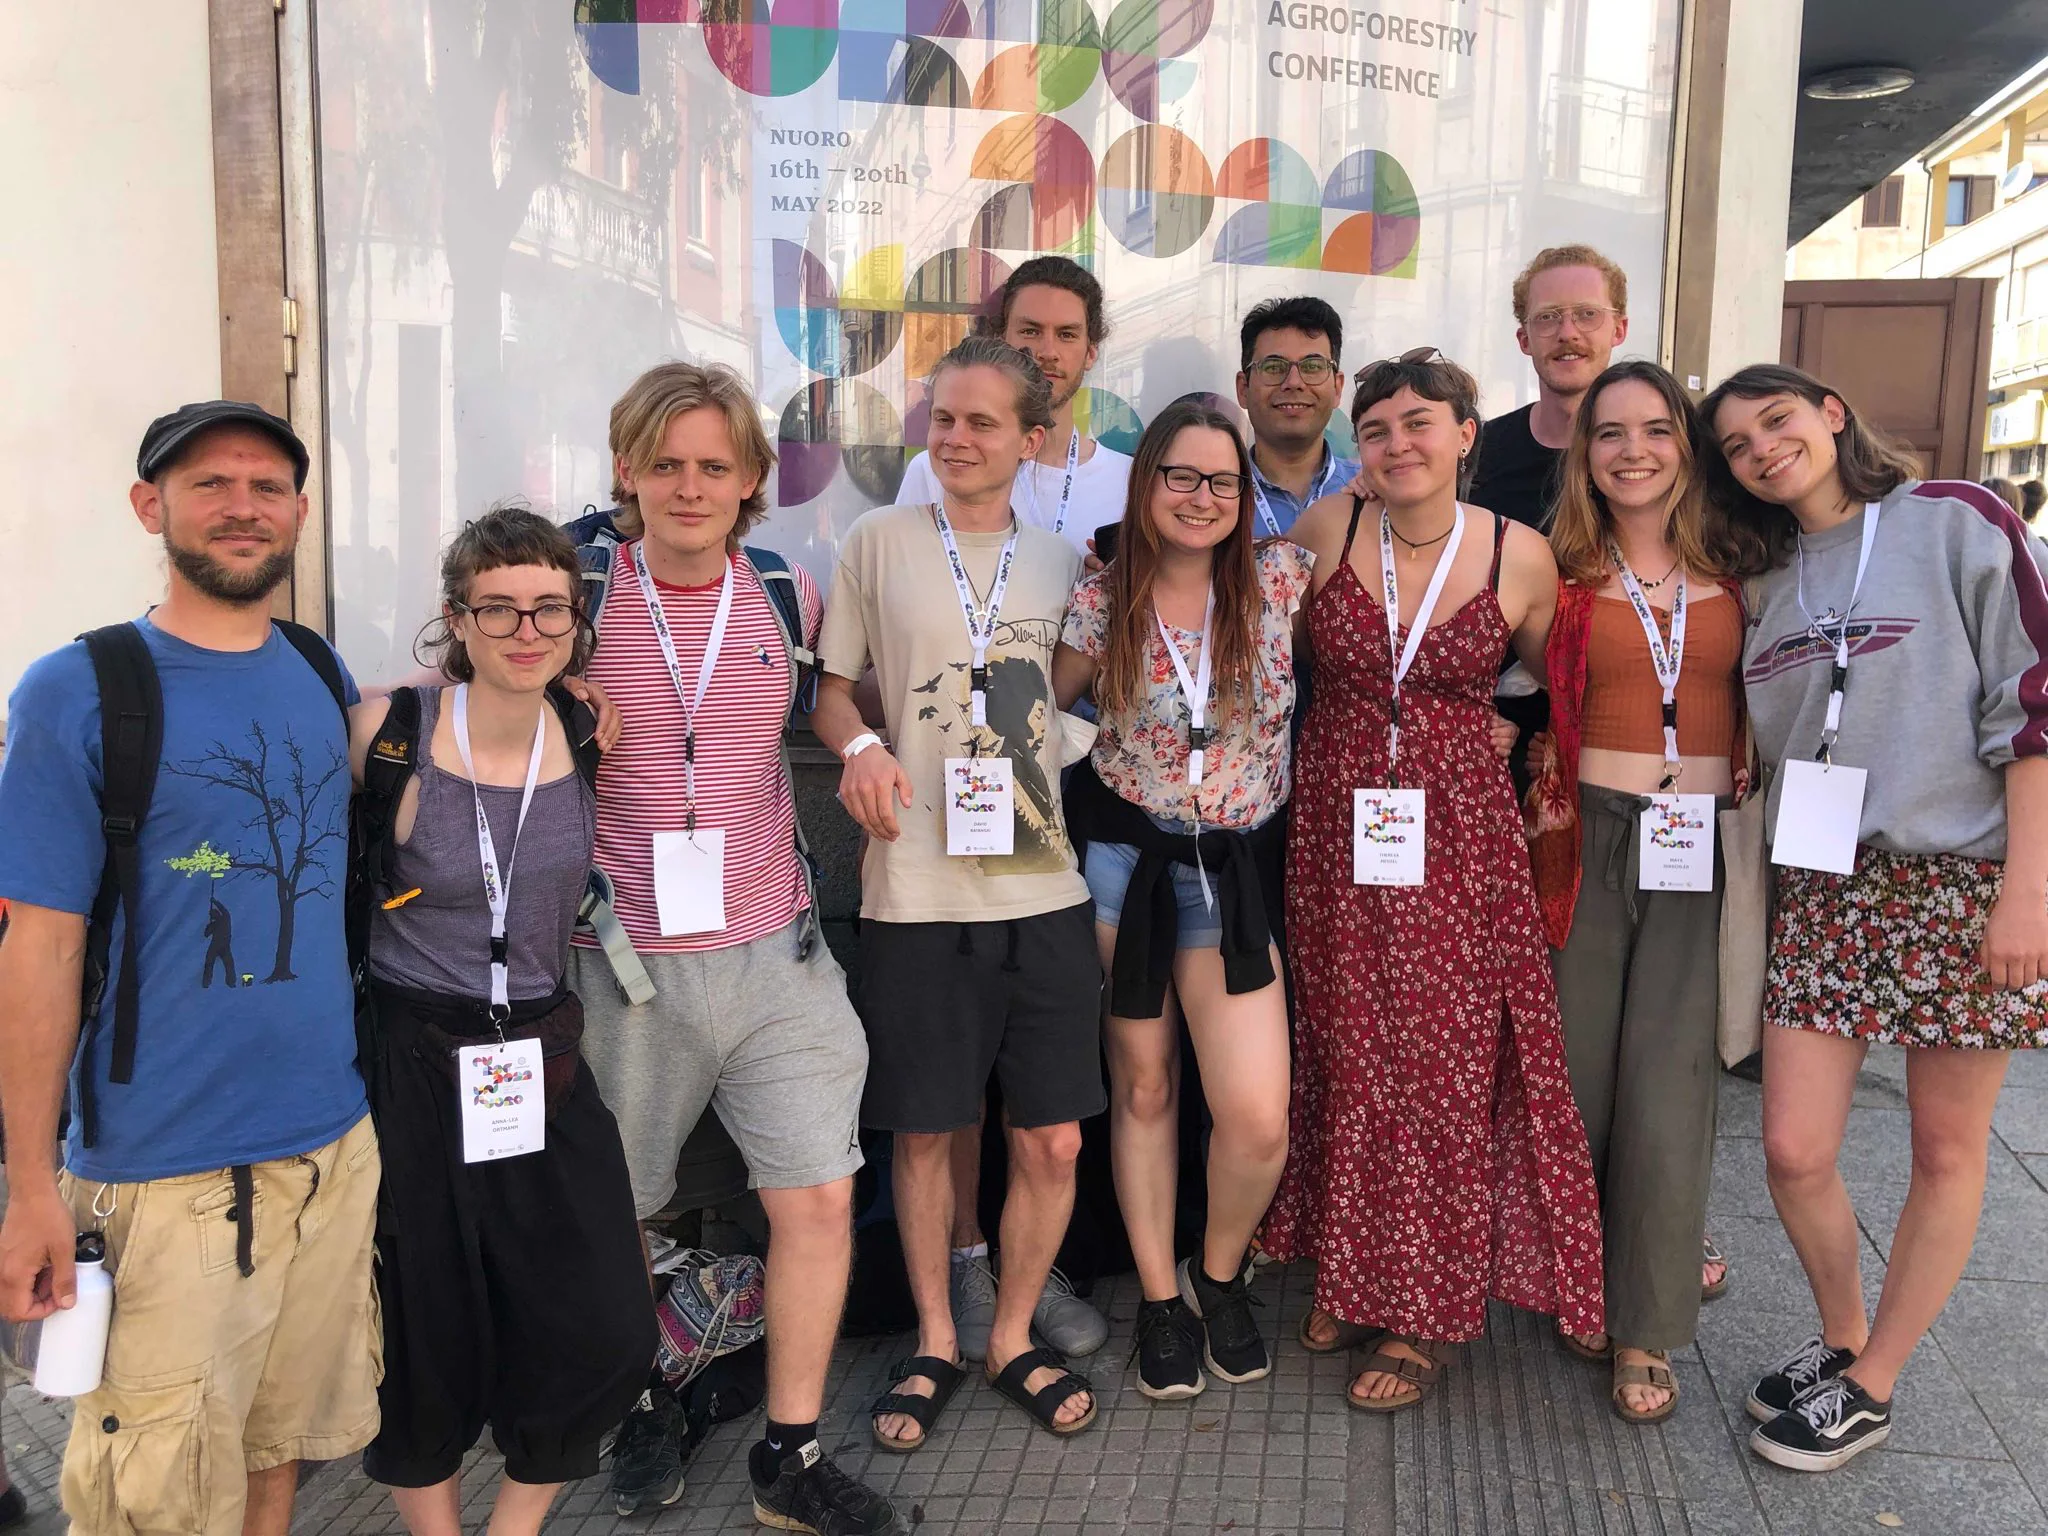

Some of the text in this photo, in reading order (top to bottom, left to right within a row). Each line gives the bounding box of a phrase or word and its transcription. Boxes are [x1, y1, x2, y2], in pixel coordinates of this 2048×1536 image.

[1267, 0, 1478, 57] AGROFORESTRY
[1268, 51, 1440, 99] CONFERENCE
[770, 129, 852, 147] NUORO
[770, 159, 820, 180] 16th
[854, 164, 909, 185] 20th
[771, 195, 883, 216] MAY 2022
